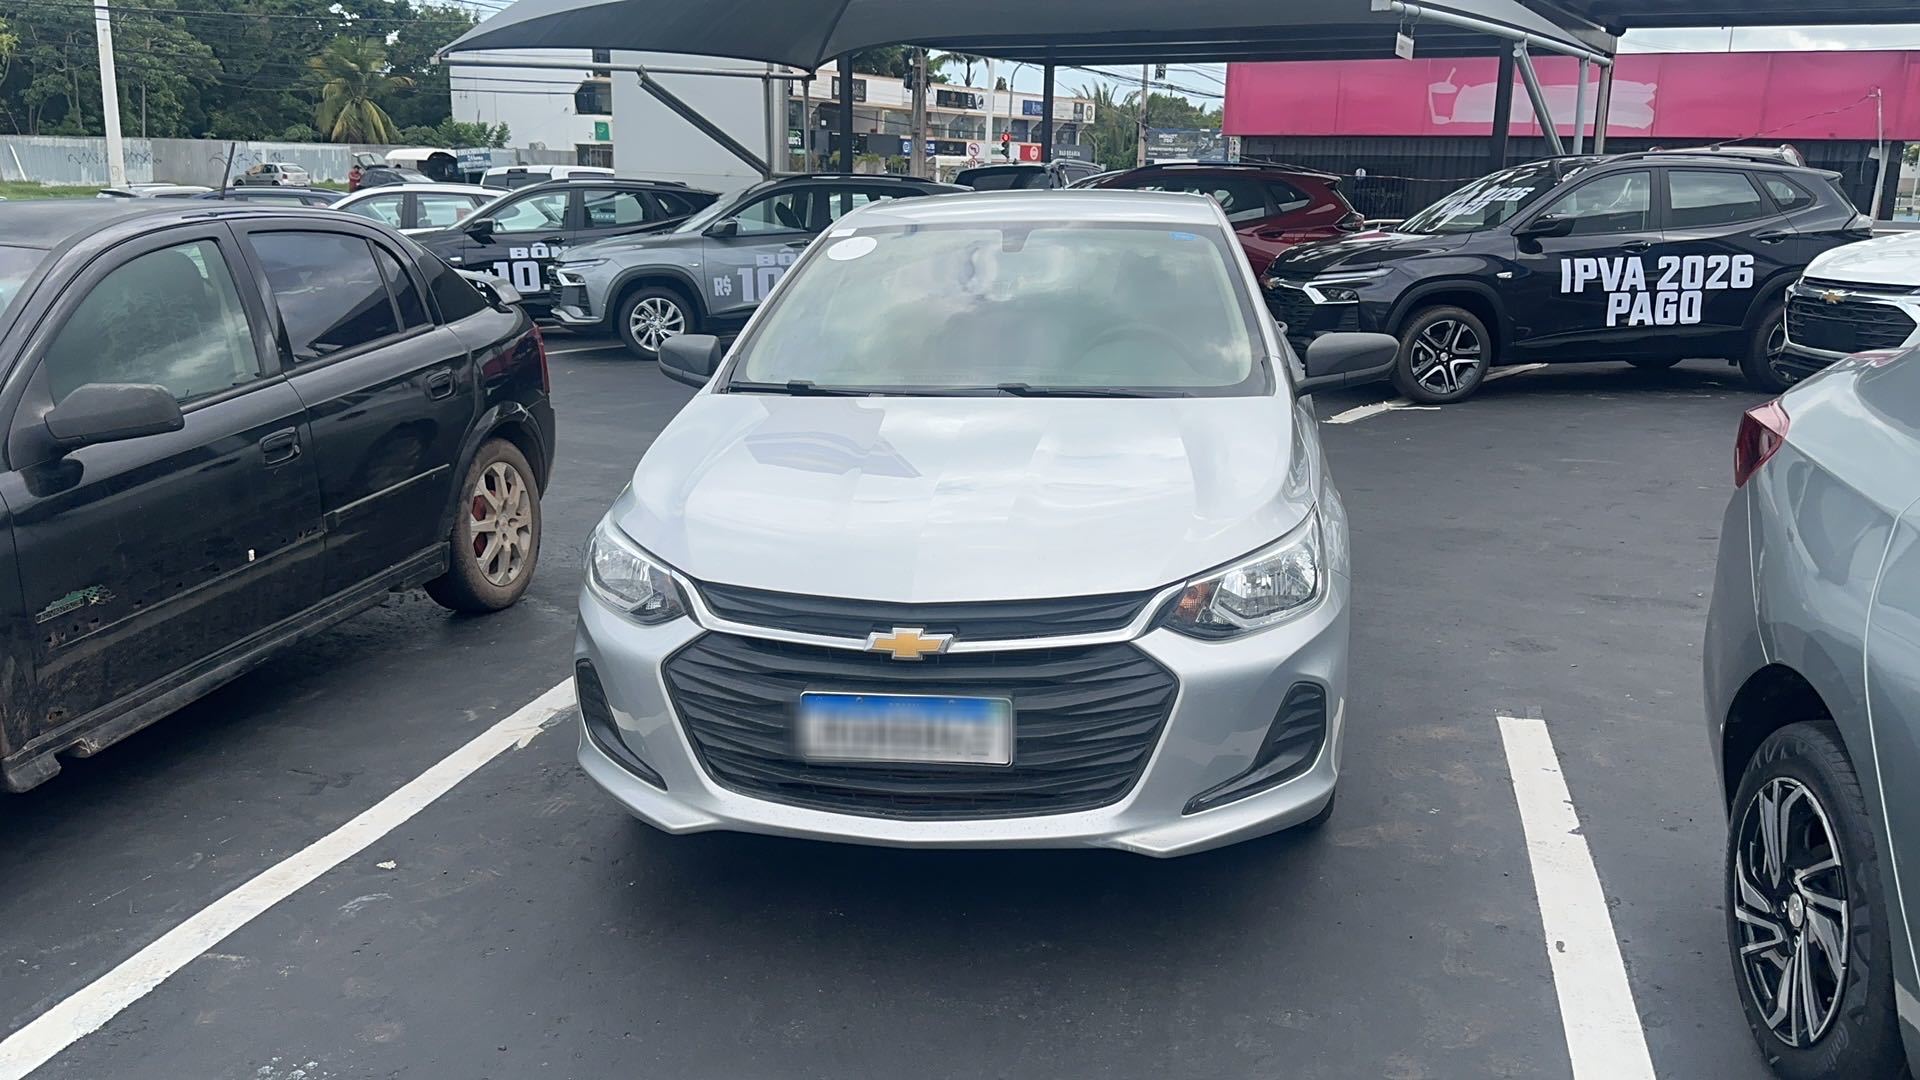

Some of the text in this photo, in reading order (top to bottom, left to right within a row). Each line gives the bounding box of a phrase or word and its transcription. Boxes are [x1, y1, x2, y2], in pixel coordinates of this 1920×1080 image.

[755, 247, 803, 266] BÔ
[713, 275, 732, 297] R$
[1560, 254, 1755, 293] IPVA 2026
[1606, 290, 1703, 327] PAGO
